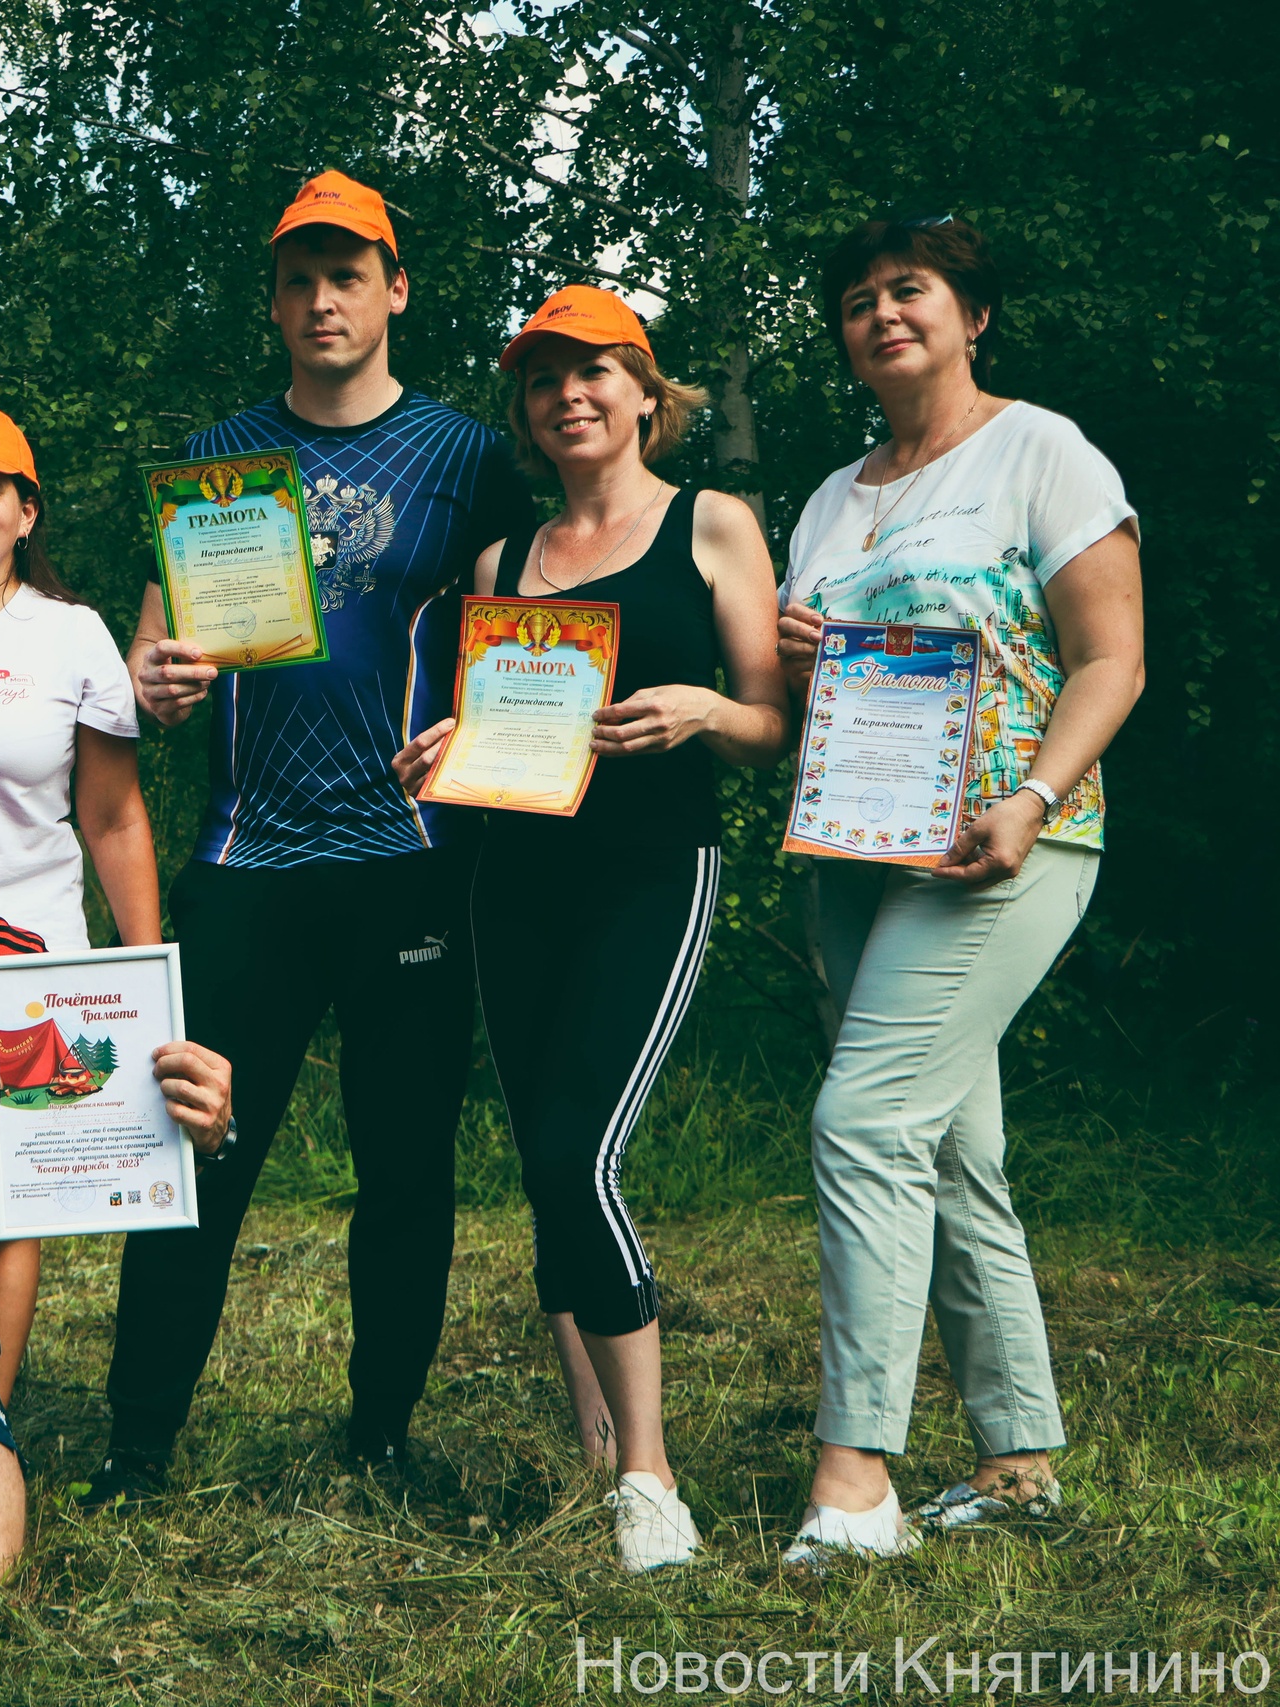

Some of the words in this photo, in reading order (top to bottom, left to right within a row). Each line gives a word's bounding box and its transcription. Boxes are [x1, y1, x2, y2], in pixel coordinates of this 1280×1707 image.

[187, 507, 268, 530] ГРАМОТА
[200, 545, 264, 559] Награждается
[949, 573, 978, 587] not
[906, 602, 952, 618] same
[495, 658, 577, 678] ГРАМОТА
[842, 656, 948, 696] Грамота
[498, 695, 564, 707] Награждается
[852, 717, 923, 731] Награждается
[399, 945, 442, 964] PUMA
[43, 992, 122, 1009] Почётная
[80, 1009, 138, 1025] Грамота
[71, 1162, 110, 1175] дружбы
